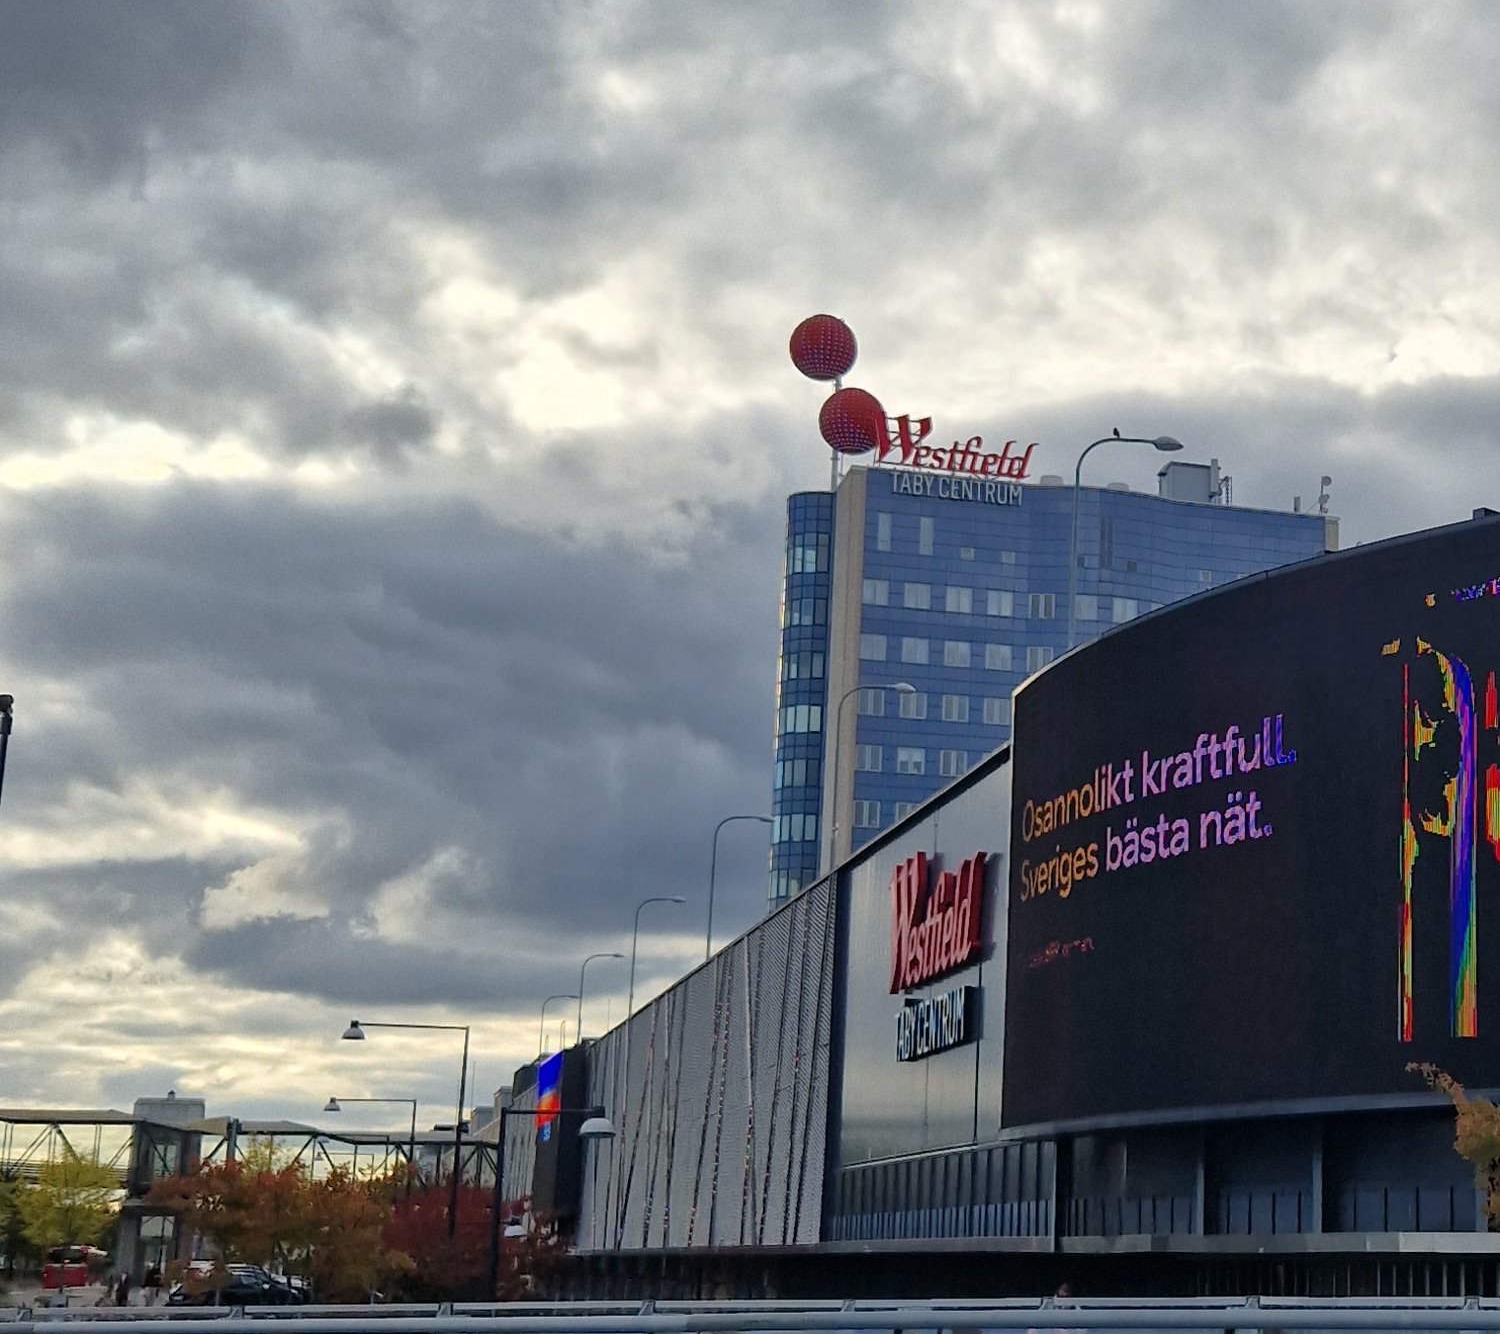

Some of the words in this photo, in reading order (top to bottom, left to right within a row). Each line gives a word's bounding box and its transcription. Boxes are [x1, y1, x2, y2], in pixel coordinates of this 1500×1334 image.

[875, 411, 1039, 479] Westfield
[939, 476, 1024, 506] CENTRUM
[1021, 759, 1135, 843] Osannolikt
[1142, 713, 1297, 797] kraftfull.
[1020, 845, 1099, 902] Sveriges
[1106, 817, 1190, 871] bästa
[1200, 790, 1273, 849] nät.
[889, 851, 986, 993] Westfield
[917, 985, 965, 1055] CENTRUM
